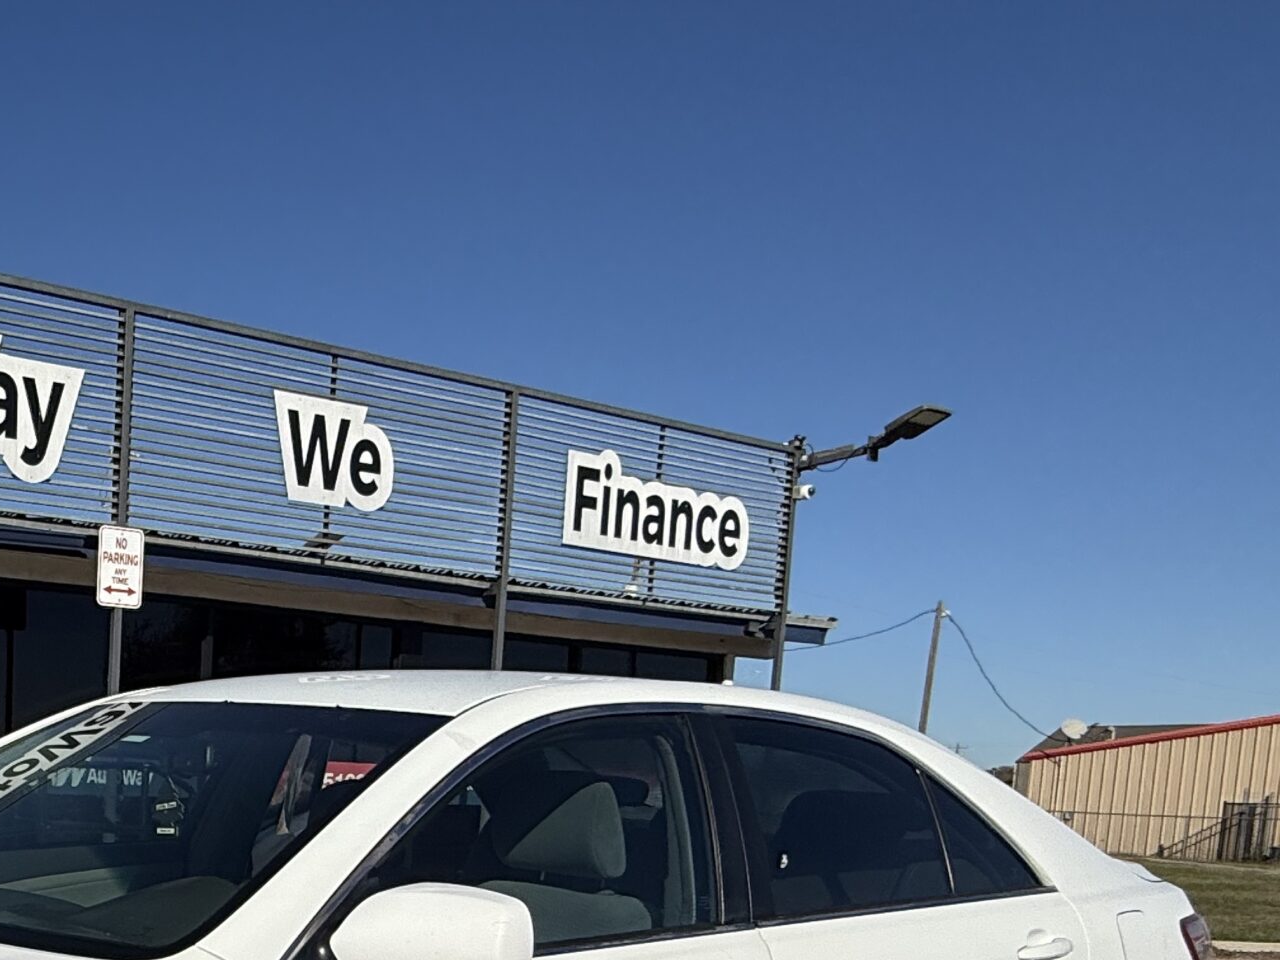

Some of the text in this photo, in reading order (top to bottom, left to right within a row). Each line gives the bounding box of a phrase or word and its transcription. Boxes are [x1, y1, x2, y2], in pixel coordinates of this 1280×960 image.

[287, 408, 382, 497] We
[573, 458, 741, 558] Finance
[115, 537, 128, 550] NO
[102, 551, 139, 566] PARKING
[111, 576, 129, 586] TIME
